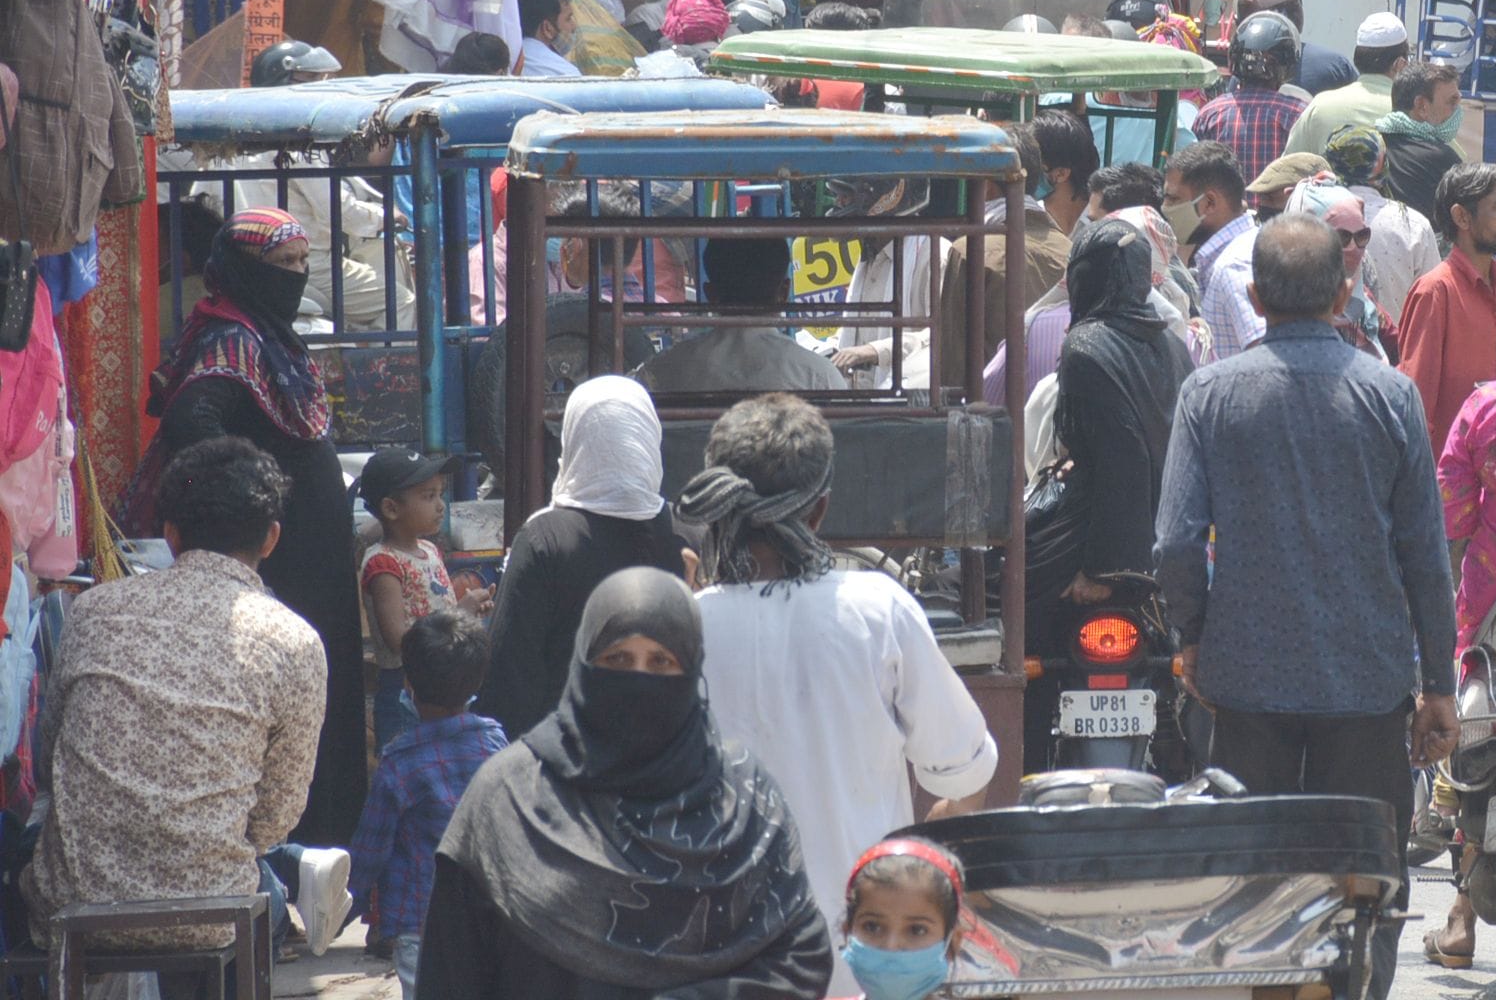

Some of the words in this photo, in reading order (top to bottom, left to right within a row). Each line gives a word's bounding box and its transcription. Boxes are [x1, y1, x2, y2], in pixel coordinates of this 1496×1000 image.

[1090, 695, 1127, 712] UP81
[1074, 718, 1095, 734] BR
[1099, 717, 1141, 733] 0338
